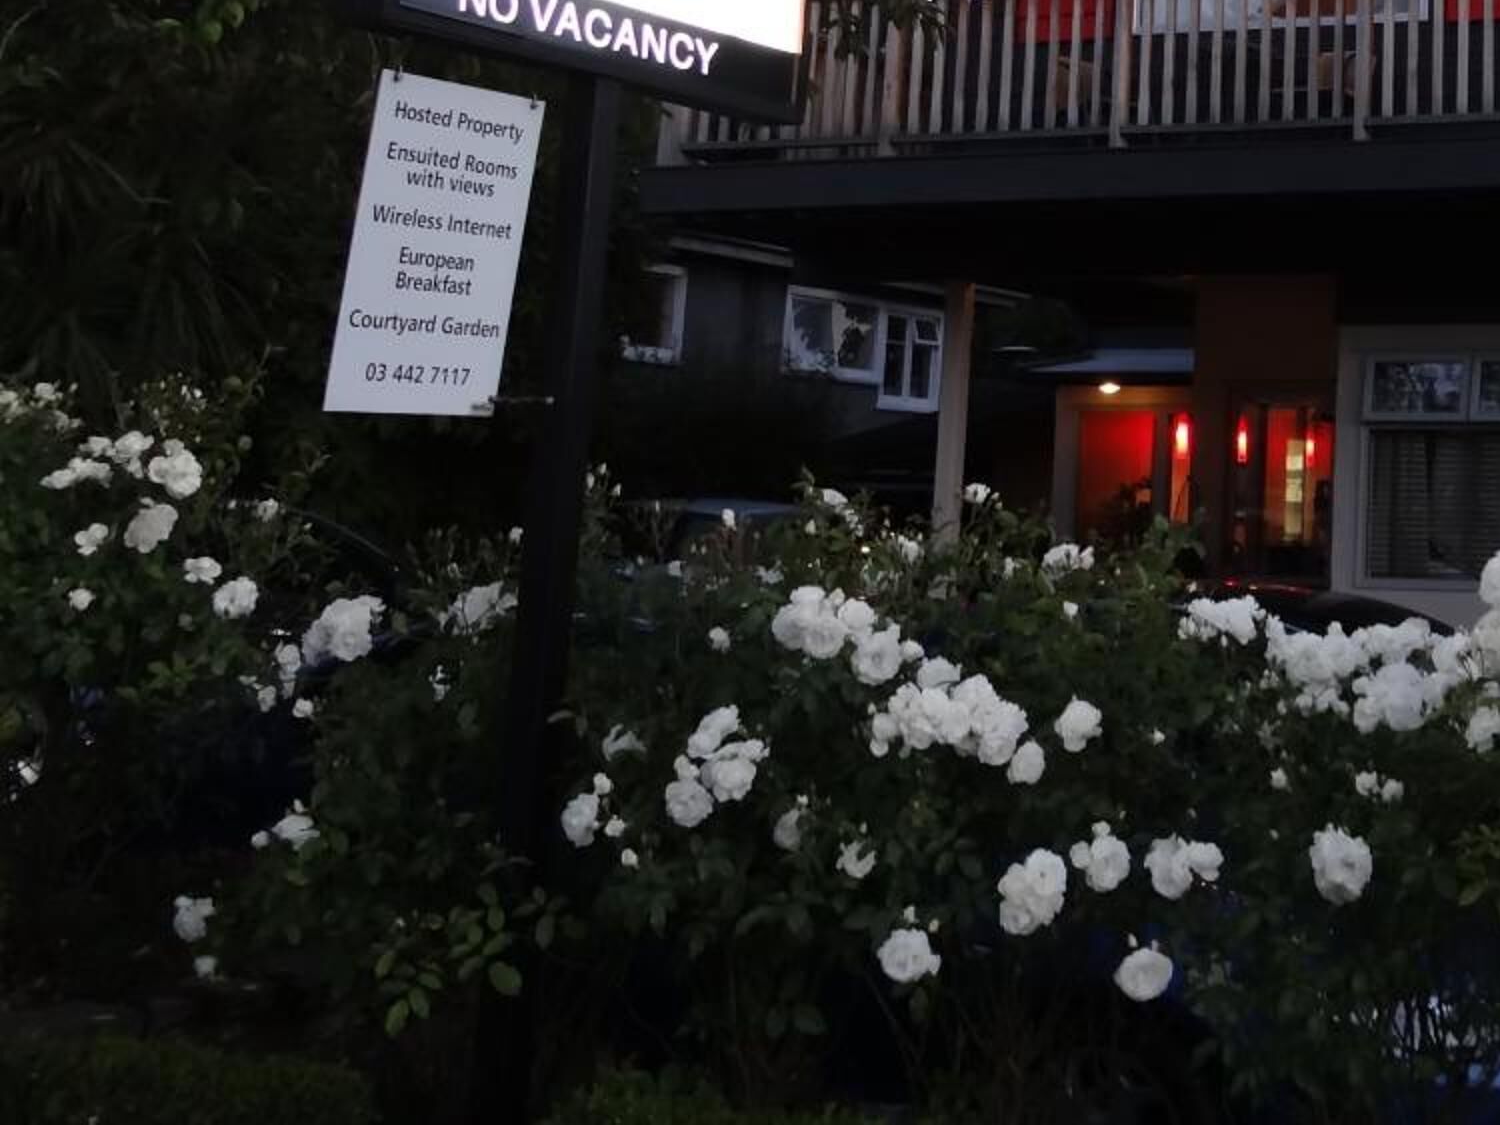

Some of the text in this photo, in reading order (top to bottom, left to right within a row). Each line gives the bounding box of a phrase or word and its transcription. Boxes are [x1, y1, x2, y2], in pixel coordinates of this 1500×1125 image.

[395, 100, 524, 145] Hosted Property
[387, 141, 518, 180] Ensuited Rooms
[407, 171, 495, 197] with views
[373, 204, 512, 240] Wireless Internet
[399, 246, 474, 272] European
[395, 272, 472, 296] Breakfast
[349, 309, 500, 338] Courtyard Garden
[365, 363, 471, 387] 03 442 7117
